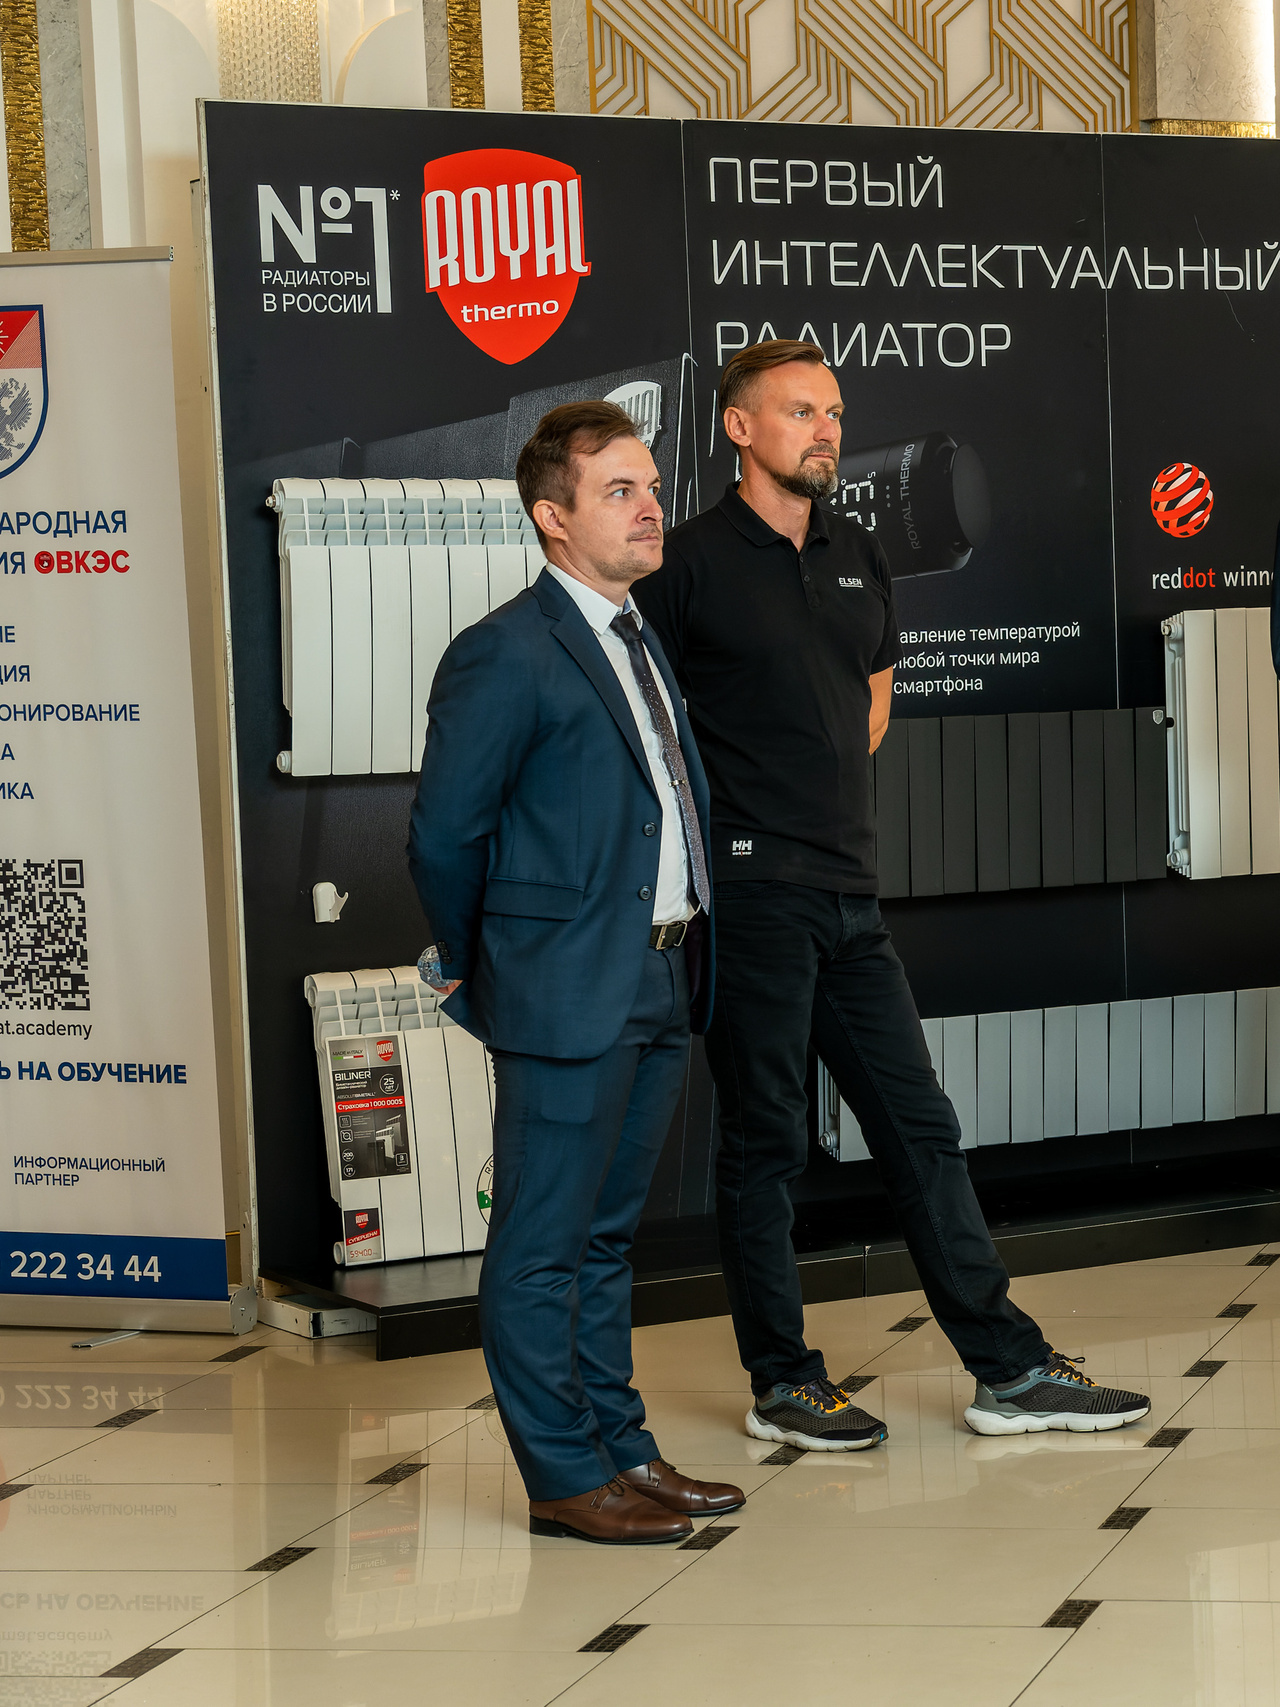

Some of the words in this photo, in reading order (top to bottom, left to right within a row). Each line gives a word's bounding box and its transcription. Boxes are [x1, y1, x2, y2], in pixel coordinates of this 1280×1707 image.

[708, 156, 943, 208] ПЕРВЫЙ
[424, 179, 590, 289] ROYAL
[262, 270, 370, 287] РАДИАТОРЫ
[263, 294, 276, 312] В
[282, 294, 371, 314] РОССИИ
[461, 299, 559, 323] thermo
[900, 443, 915, 500] THERMO
[0, 510, 127, 538] АРОДНАЯ
[902, 501, 921, 550] ROYAL
[1152, 567, 1216, 589] reddot
[900, 629, 966, 644] авление
[969, 622, 1081, 643] температурой
[949, 653, 995, 667] точки
[1000, 651, 1040, 667] мира
[0, 665, 31, 685] ИЯ
[893, 676, 983, 696] смартфона
[0, 704, 140, 722] ОНИРОВАНИЕ
[732, 840, 753, 851] HH
[18, 1061, 52, 1081] НА
[58, 1062, 187, 1084] ОБУЧЕНИЕ
[334, 1071, 371, 1082] BILINER
[383, 1077, 395, 1086] 25
[337, 1102, 369, 1111] Страховка
[13, 1156, 166, 1172] ИНФОРМАЦИОННЫЙ
[14, 1173, 80, 1186] ПАРТНЕР
[9, 1251, 67, 1279] 222
[76, 1253, 114, 1281] 34
[123, 1255, 162, 1283] 44
